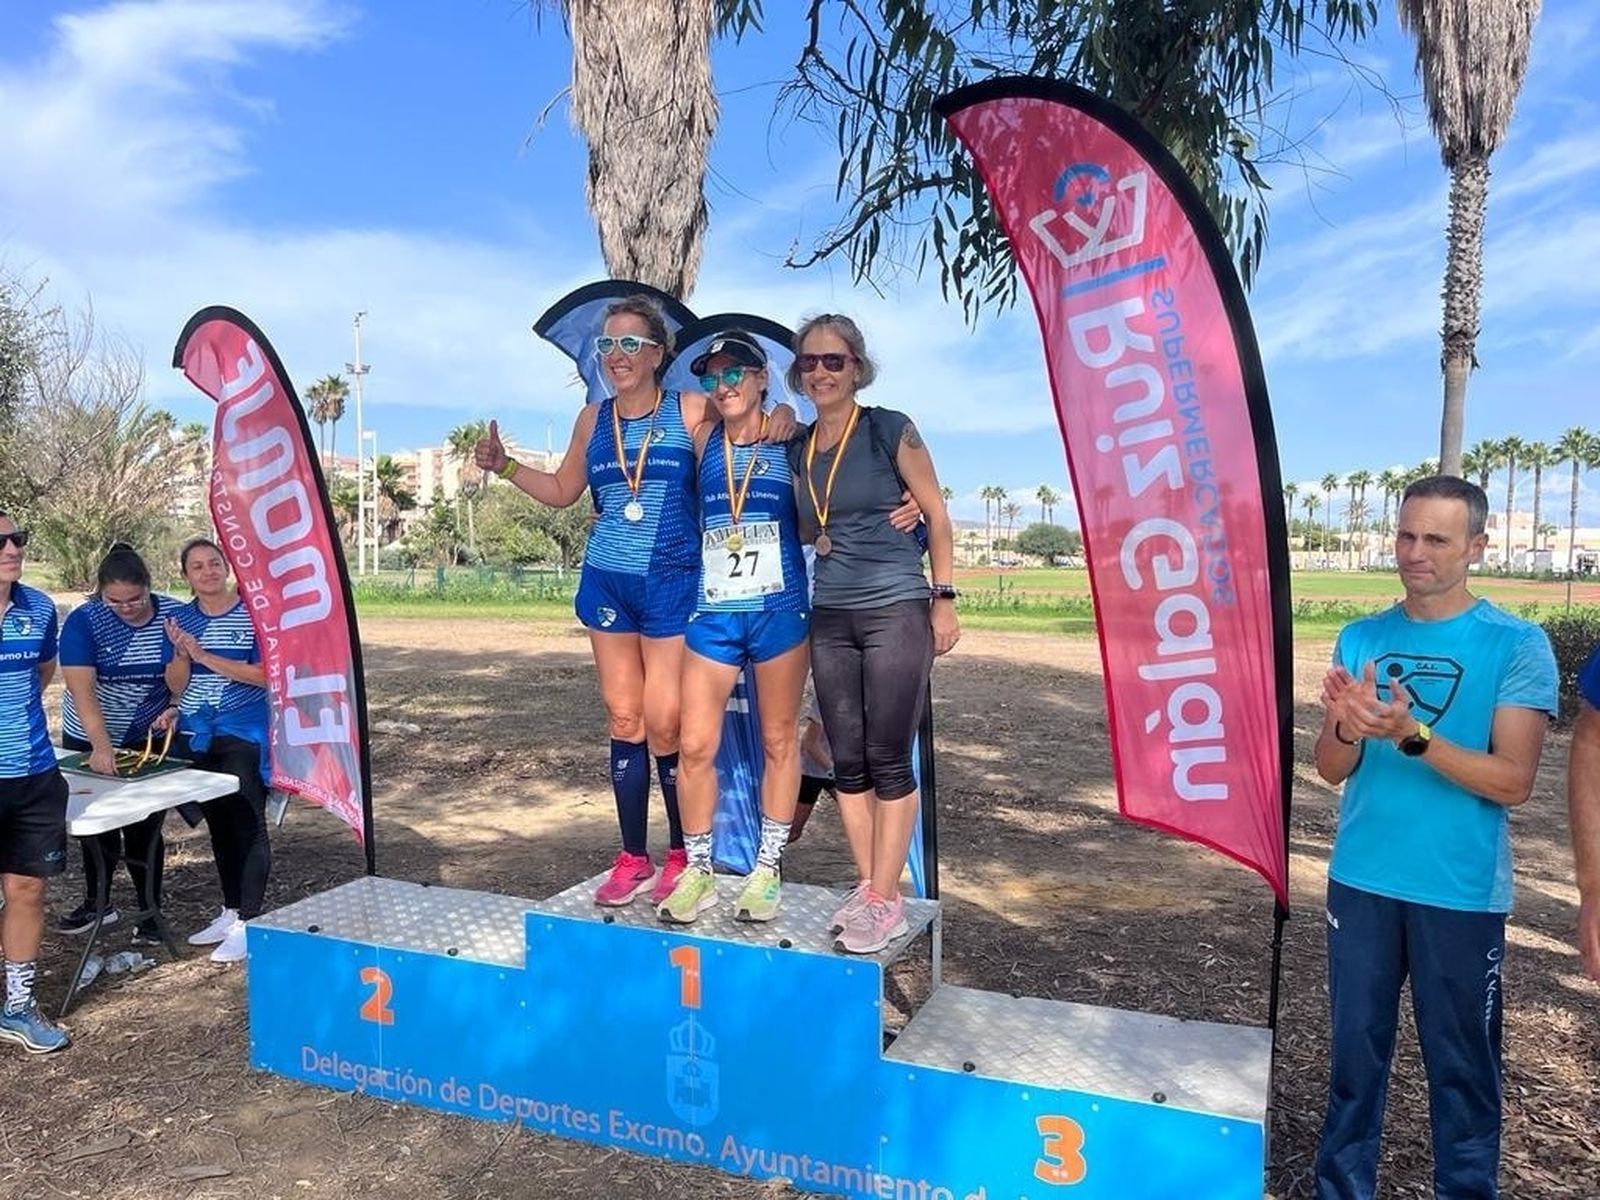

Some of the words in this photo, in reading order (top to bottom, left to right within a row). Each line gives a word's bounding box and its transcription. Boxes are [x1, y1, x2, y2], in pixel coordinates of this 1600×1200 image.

[727, 550, 759, 578] 27
[360, 967, 395, 1026] 2
[669, 945, 702, 1009] 1
[301, 1046, 433, 1101] Delegación
[439, 1077, 472, 1107] de
[479, 1084, 601, 1134] Deportes
[608, 1109, 711, 1161] Excmo.
[1034, 1114, 1087, 1185] 3
